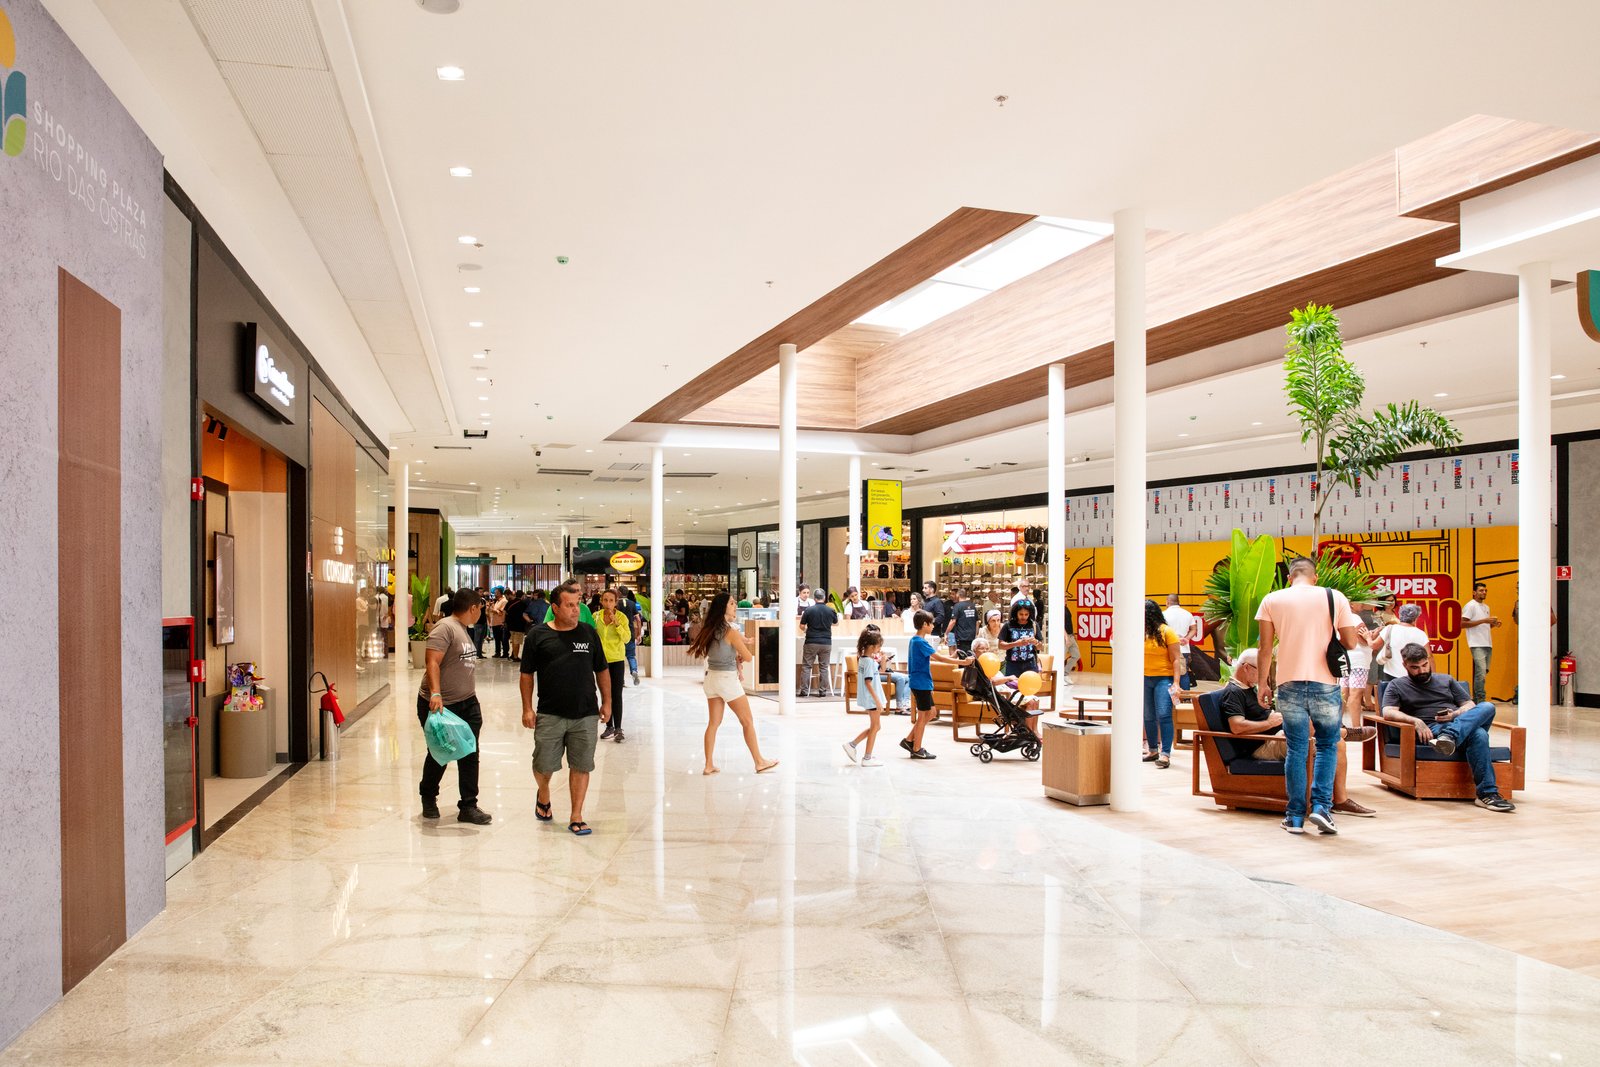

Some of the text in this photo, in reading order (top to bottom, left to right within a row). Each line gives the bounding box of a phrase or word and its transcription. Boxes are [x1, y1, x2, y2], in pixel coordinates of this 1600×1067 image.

[33, 101, 147, 226] SHOPPING PLAZA
[33, 131, 147, 259] RIO DAS OSTRAS
[1376, 578, 1438, 595] SUPER
